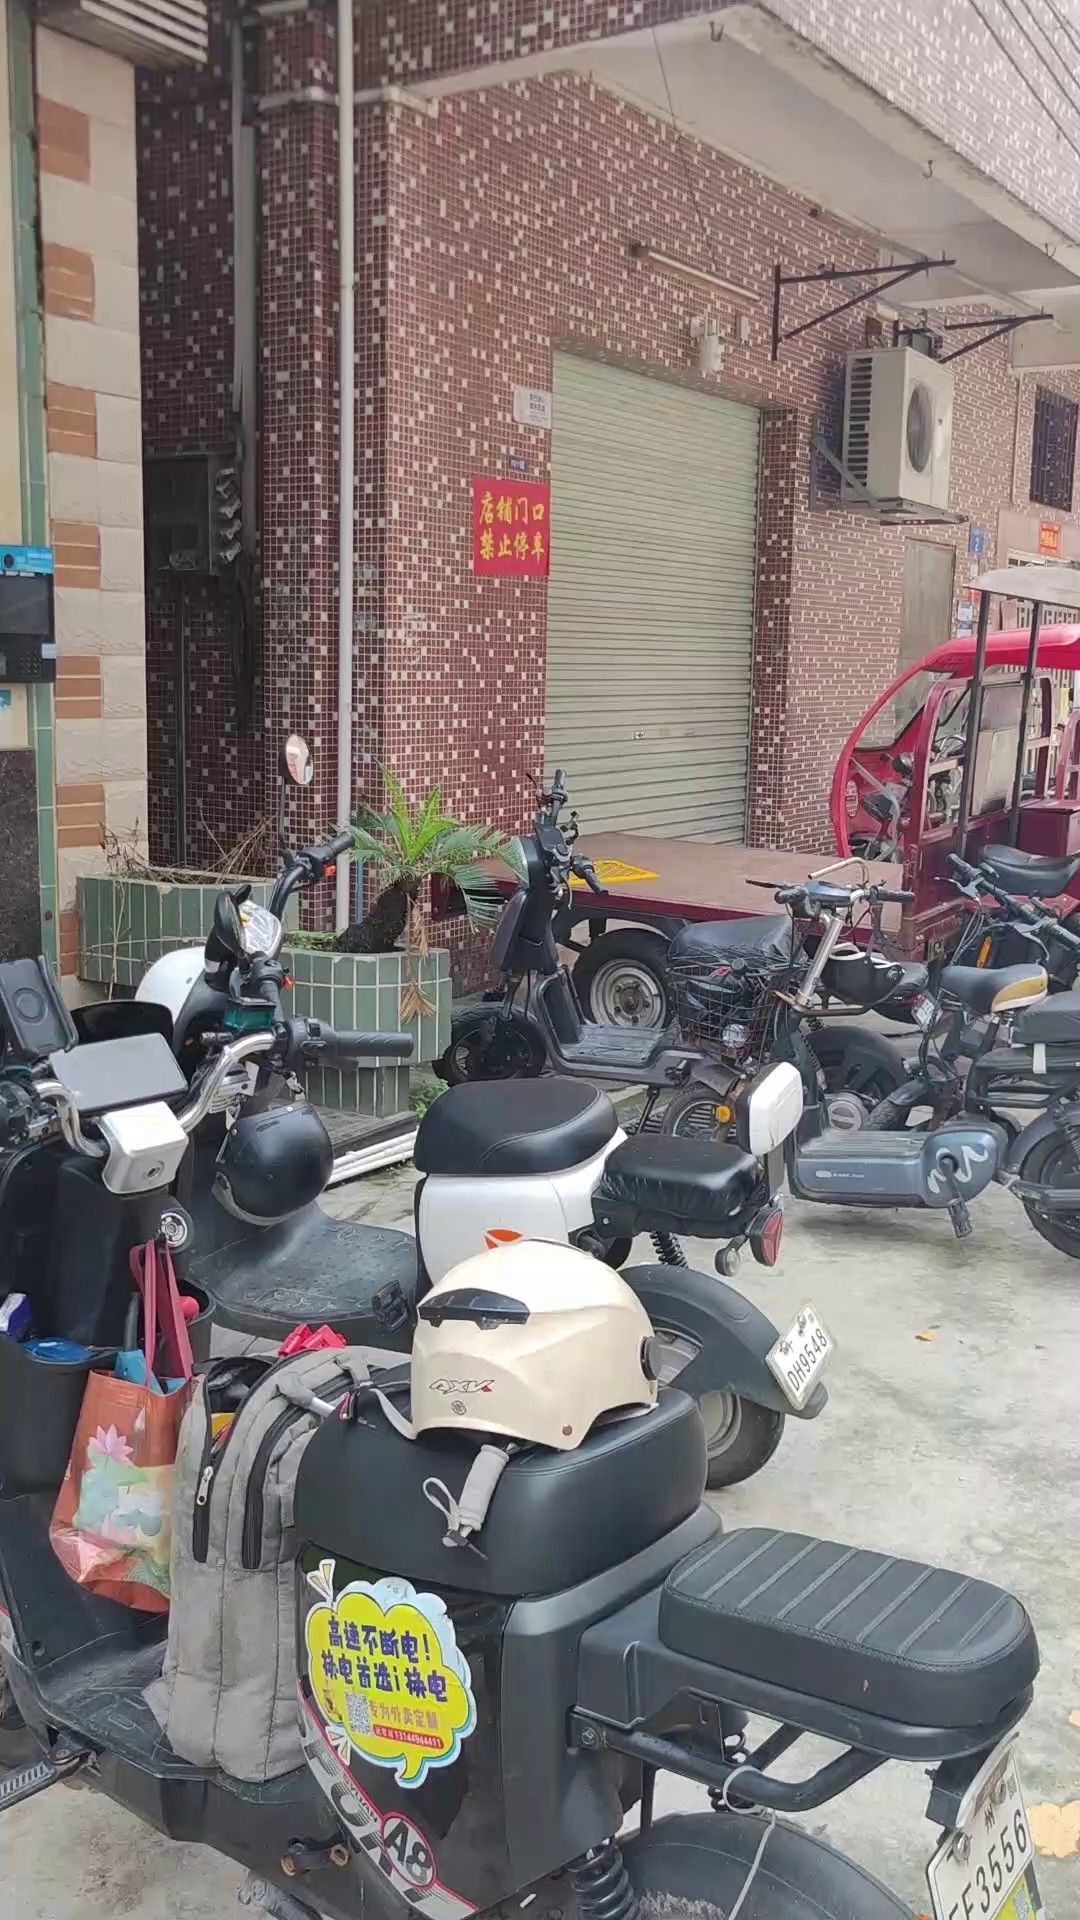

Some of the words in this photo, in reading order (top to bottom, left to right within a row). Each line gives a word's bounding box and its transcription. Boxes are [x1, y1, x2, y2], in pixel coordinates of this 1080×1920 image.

[479, 491, 544, 525] 店铺门口
[479, 528, 545, 565] 禁止停车
[384, 1820, 433, 1884] A8
